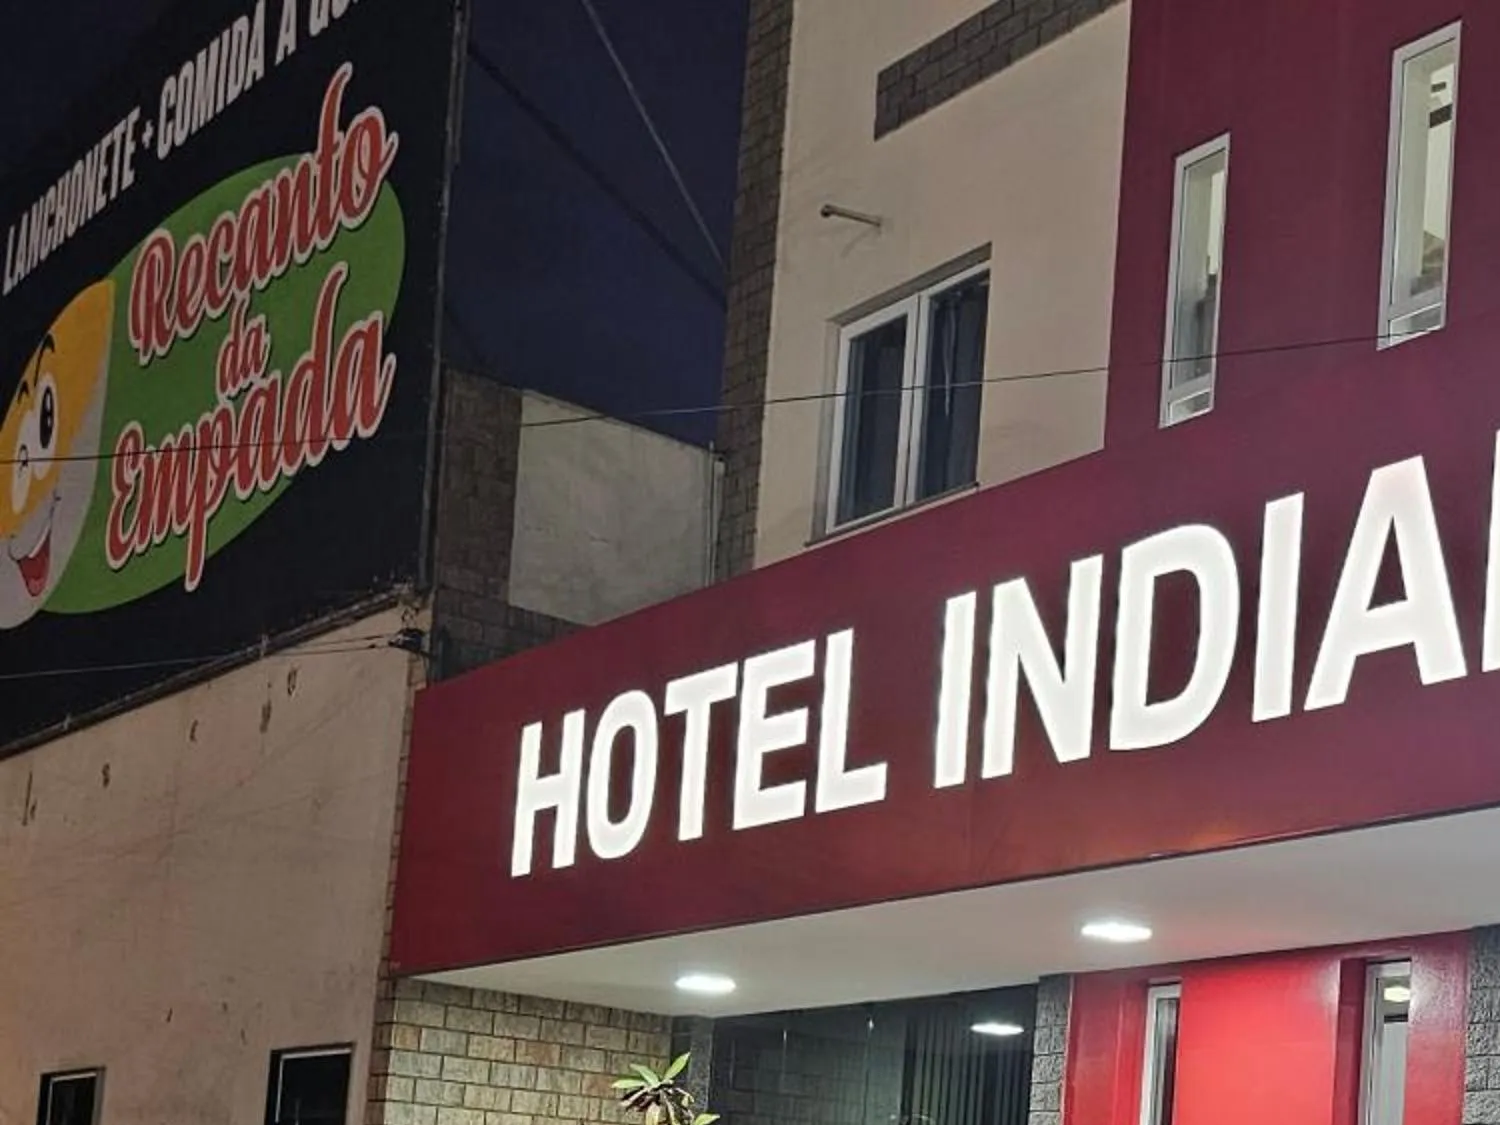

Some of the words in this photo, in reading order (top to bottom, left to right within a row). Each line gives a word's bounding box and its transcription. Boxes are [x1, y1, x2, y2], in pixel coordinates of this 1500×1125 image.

[3, 105, 141, 296] LANCHONETE
[157, 0, 265, 160] COMIDA
[129, 62, 398, 367] Recanto
[105, 261, 397, 592] Empada
[215, 298, 272, 400] da
[511, 628, 888, 877] HOTEL
